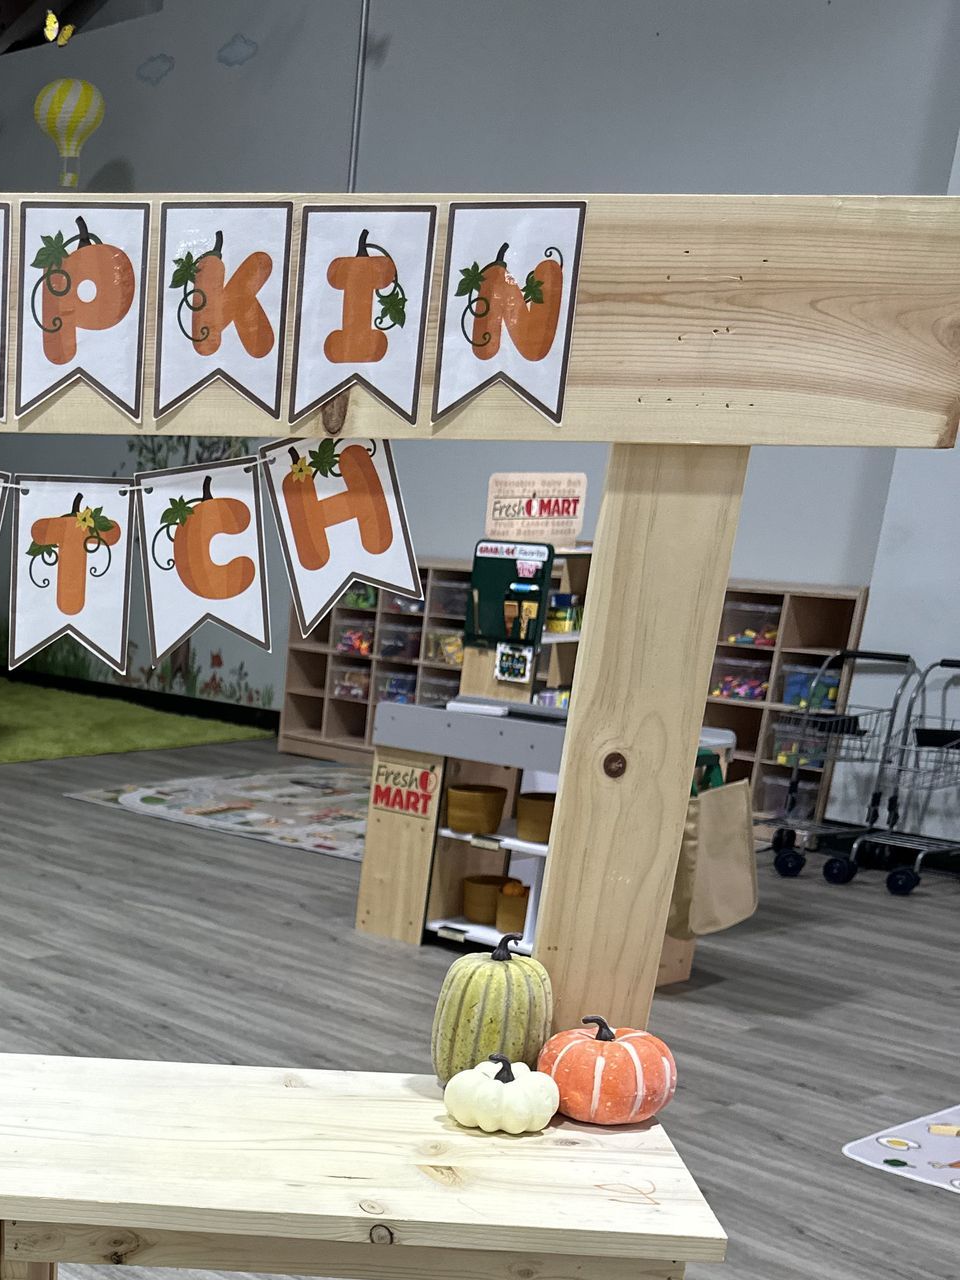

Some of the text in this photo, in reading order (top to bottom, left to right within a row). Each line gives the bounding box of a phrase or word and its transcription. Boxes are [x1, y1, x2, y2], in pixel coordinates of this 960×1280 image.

[492, 498, 580, 519] Fresh MART
[375, 764, 419, 790] Fresh
[373, 784, 432, 815] MART
